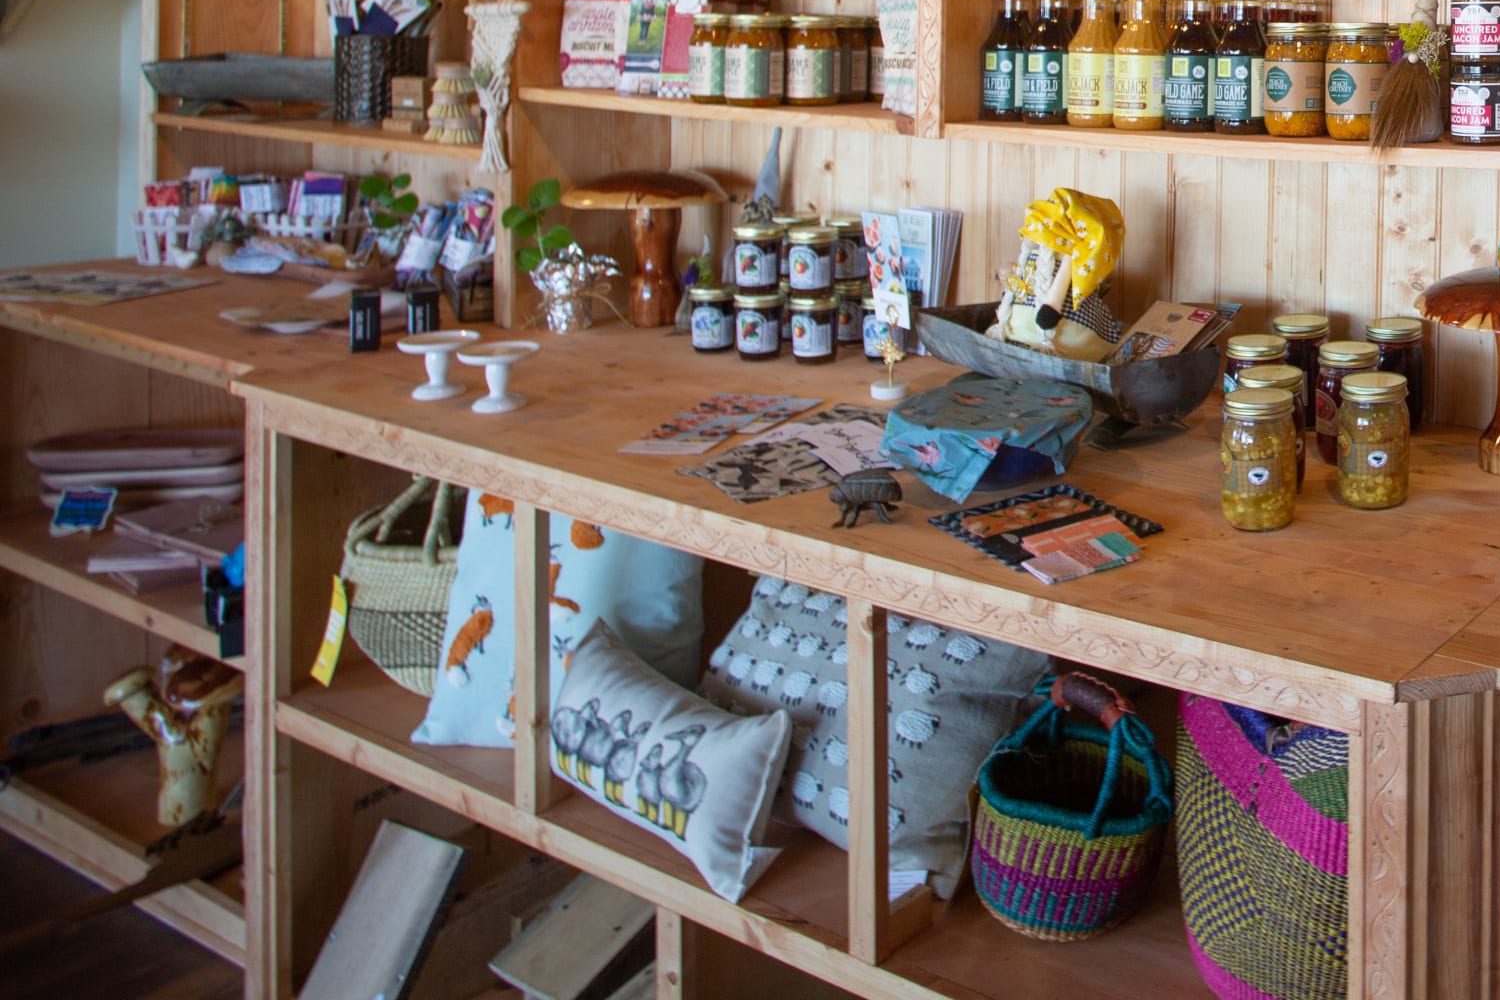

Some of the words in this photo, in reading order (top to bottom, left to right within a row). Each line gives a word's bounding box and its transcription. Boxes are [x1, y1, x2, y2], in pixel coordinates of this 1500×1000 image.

[1454, 25, 1498, 34] UNCURED
[991, 78, 1011, 90] FIELD
[1036, 79, 1058, 92] FIELD
[1180, 85, 1204, 99] GAME
[1224, 86, 1248, 100] GAME
[1470, 116, 1490, 125] JAM
